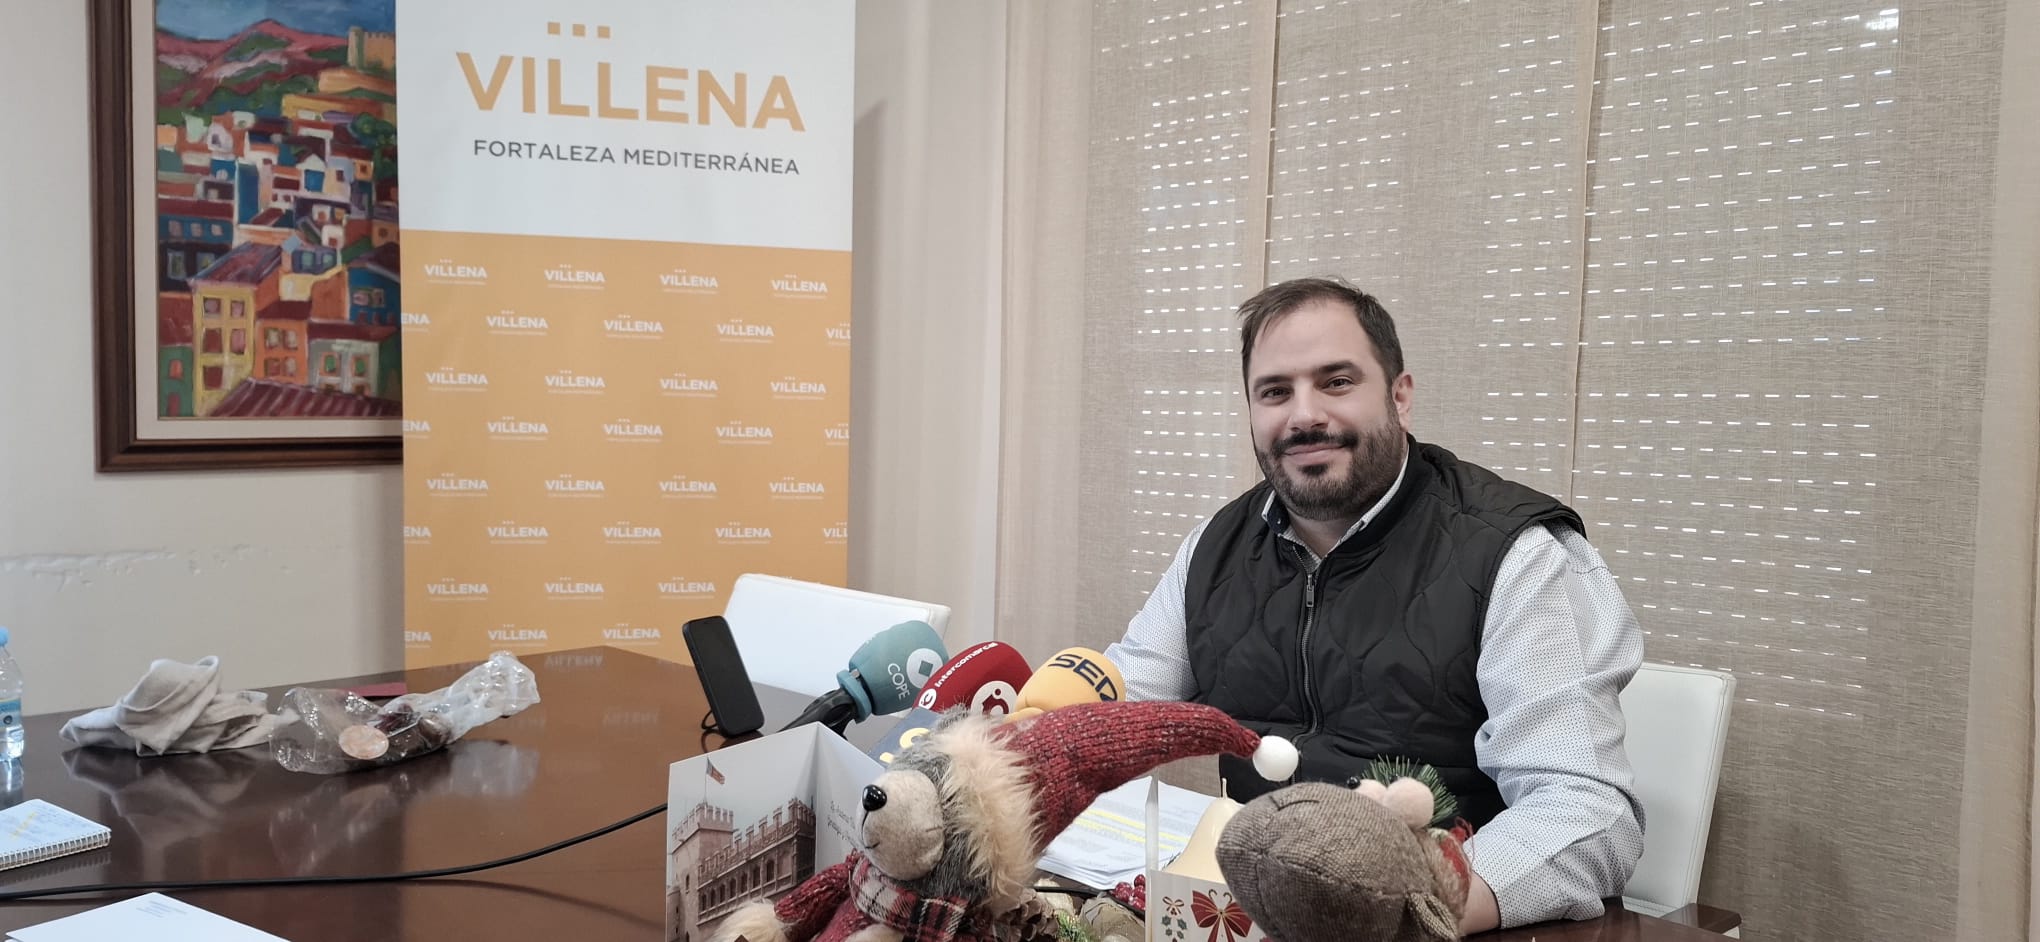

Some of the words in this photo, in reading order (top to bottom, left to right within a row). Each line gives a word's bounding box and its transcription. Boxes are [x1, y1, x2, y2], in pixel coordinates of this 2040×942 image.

[456, 51, 806, 132] VILLENA
[473, 139, 616, 164] FORTALEZA
[623, 148, 800, 176] MEDITERRÁNEA
[424, 264, 488, 280] VILLENA
[543, 269, 606, 283] VILLENA
[659, 274, 719, 289] VILLENA
[771, 279, 828, 294] VILLENA
[486, 315, 549, 330] VILLENA
[603, 319, 664, 334] VILLENA
[716, 324, 775, 338] VILLENA
[425, 372, 489, 386] VILLENA
[544, 375, 606, 389] VILLENA
[659, 378, 719, 392] VILLENA
[770, 381, 827, 395] VILLENA
[487, 421, 549, 435] VILLENA
[603, 423, 664, 437] VILLENA
[715, 426, 774, 439] VILLENA
[426, 478, 489, 492] VILLENA
[545, 479, 606, 492] VILLENA
[659, 480, 717, 493] VILLENA
[768, 481, 825, 494] VILLENA
[487, 525, 549, 539] VILLENA
[603, 527, 662, 539] VILLENA
[715, 527, 772, 539] VILLENA
[427, 583, 489, 595] VILLENA
[544, 582, 605, 594] VILLENA
[658, 581, 716, 594] VILLENA
[487, 629, 548, 641] VILLENA
[602, 627, 661, 640] VILLENA
[887, 662, 911, 701] COPE
